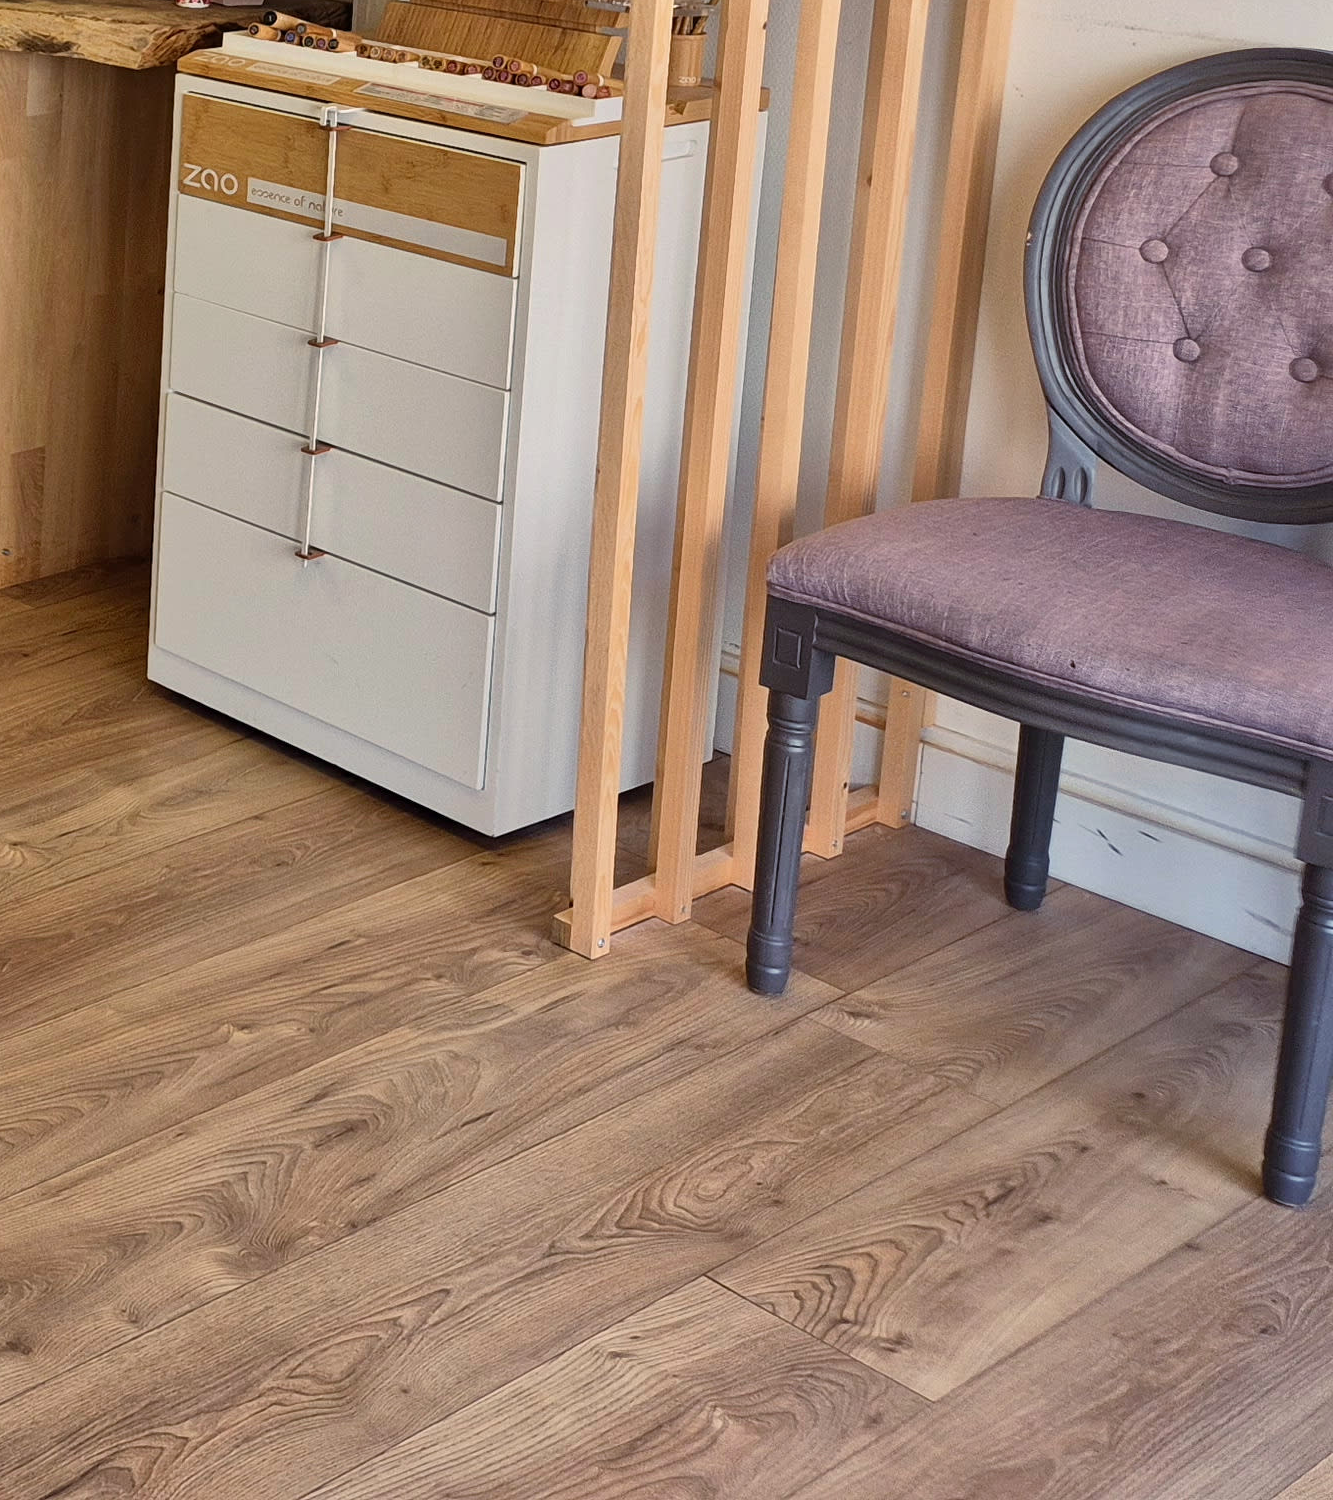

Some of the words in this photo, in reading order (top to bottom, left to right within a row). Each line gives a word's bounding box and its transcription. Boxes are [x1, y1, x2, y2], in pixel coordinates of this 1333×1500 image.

[195, 53, 246, 67] zao
[183, 163, 239, 195] zao
[250, 187, 290, 204] essence
[294, 195, 306, 207] of
